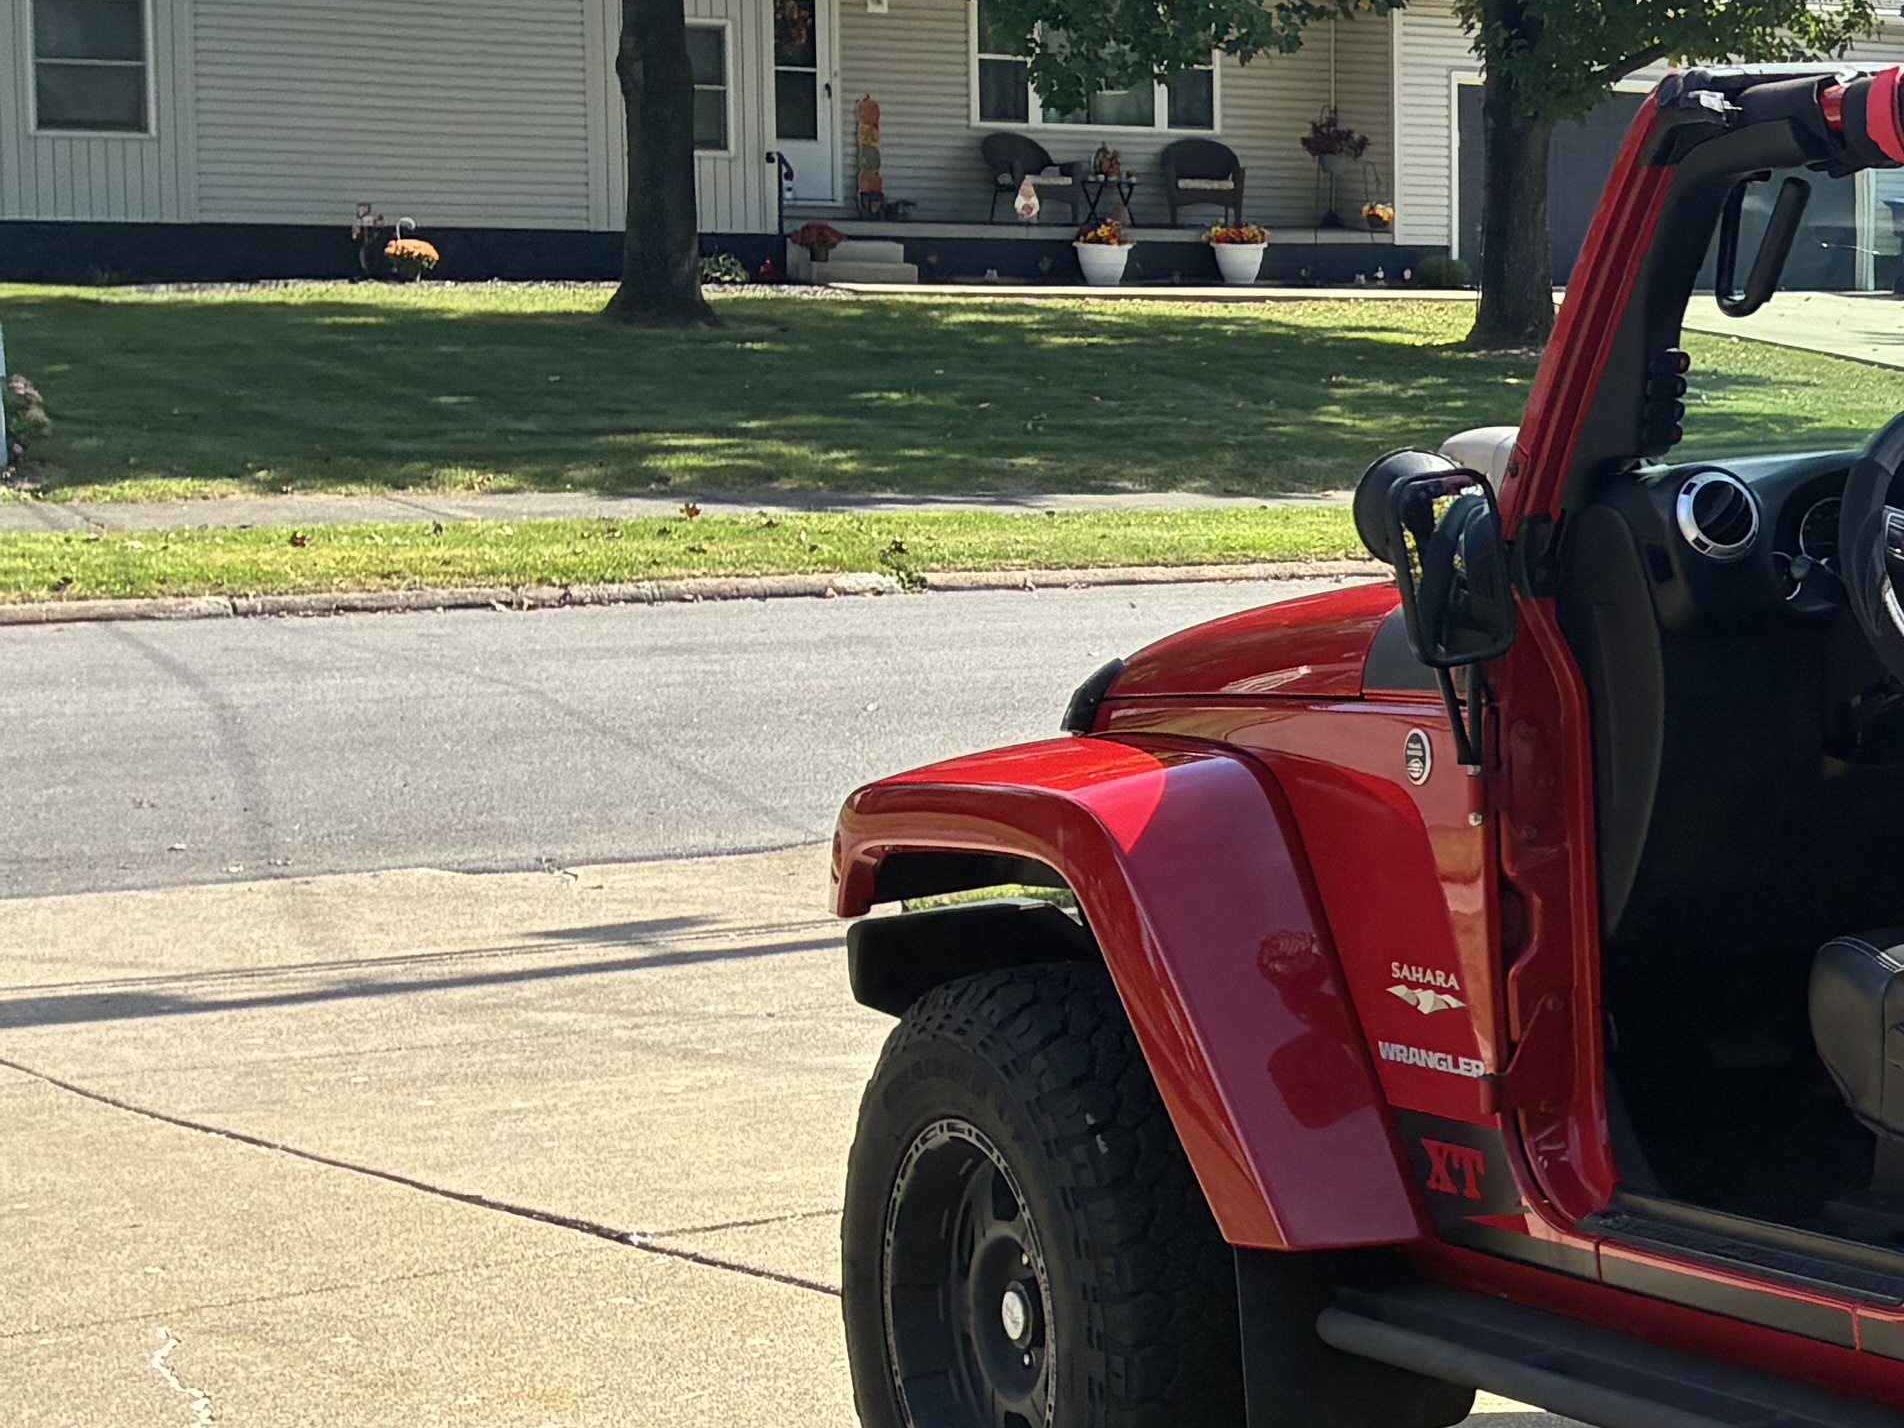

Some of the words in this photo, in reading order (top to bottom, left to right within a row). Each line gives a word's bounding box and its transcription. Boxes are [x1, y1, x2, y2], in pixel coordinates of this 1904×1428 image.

[1390, 961, 1460, 990] SAHARA
[1378, 1041, 1486, 1078] WRANGLER
[1420, 1138, 1487, 1200] XT
